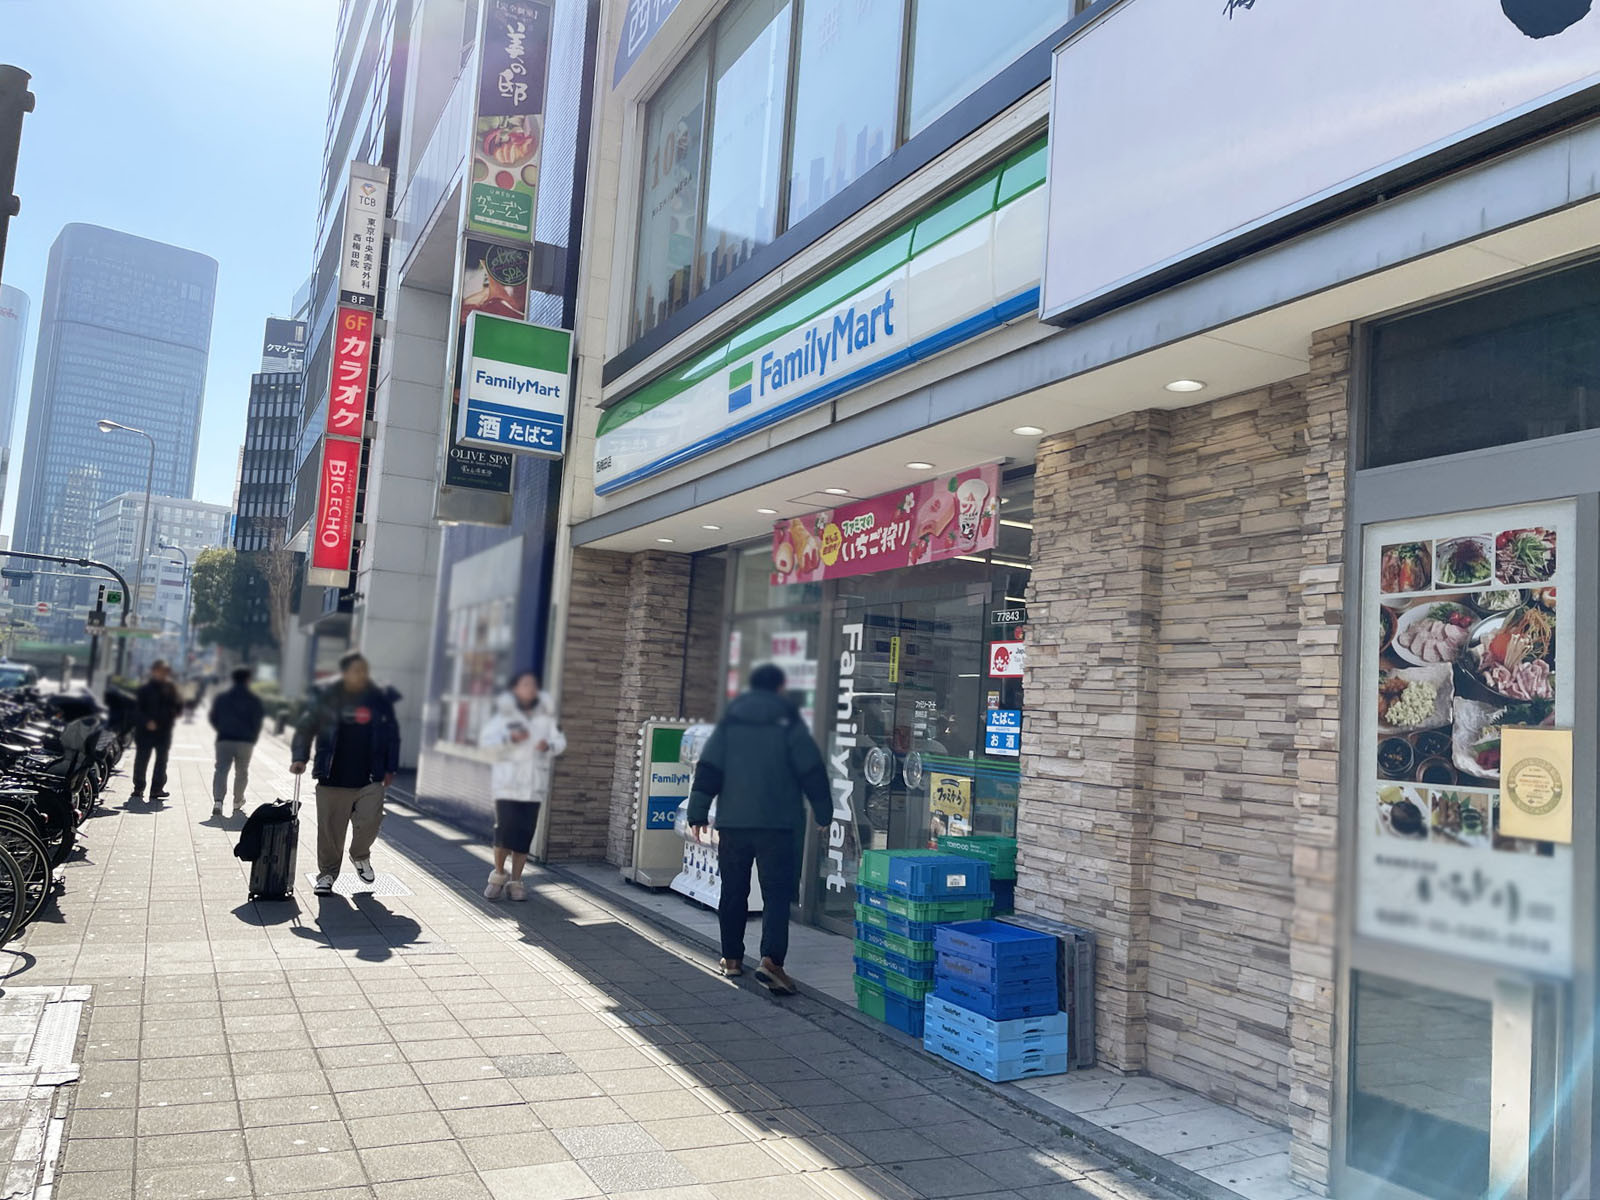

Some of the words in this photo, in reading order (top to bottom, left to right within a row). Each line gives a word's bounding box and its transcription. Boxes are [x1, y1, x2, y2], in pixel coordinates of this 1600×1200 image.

[359, 195, 376, 207] TCB
[476, 195, 528, 215] ガーデン
[350, 234, 361, 269] 西梅田院
[361, 218, 376, 289] 東京中央美容外科
[351, 295, 365, 305] 8F
[344, 315, 367, 331] 6F
[760, 289, 894, 396] FamilyMart
[333, 336, 366, 428] カラオケ
[476, 370, 560, 398] FamilyMart
[476, 414, 501, 440] 酒
[508, 422, 553, 446] たばこ
[450, 448, 487, 462] OLIVE
[329, 459, 347, 495] BIG
[321, 497, 343, 548] ECHO
[842, 513, 874, 537] ファミマの
[842, 520, 910, 561] いちご狩り
[997, 611, 1020, 621] 77843
[992, 712, 1015, 725] たばこ
[826, 623, 863, 894] FamilyMart
